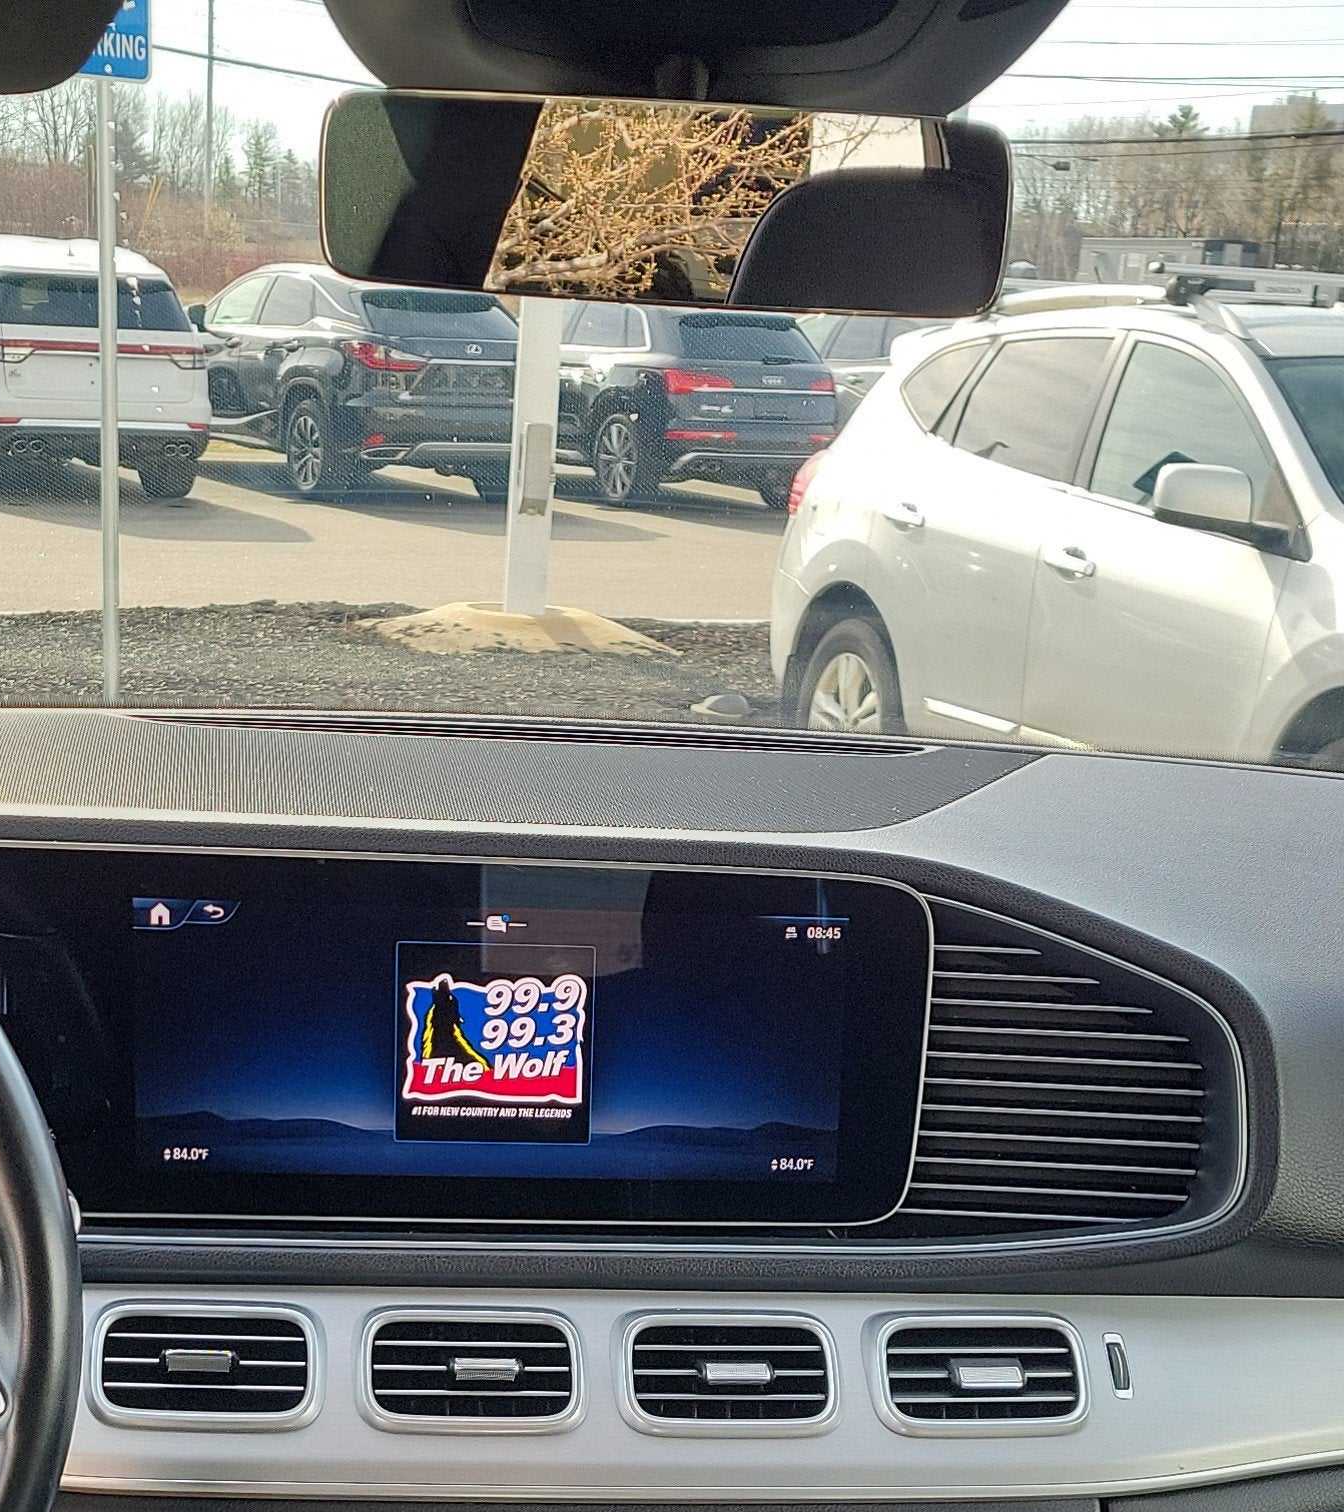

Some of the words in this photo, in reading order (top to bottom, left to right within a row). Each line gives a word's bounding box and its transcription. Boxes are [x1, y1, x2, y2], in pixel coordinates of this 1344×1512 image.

[93, 32, 146, 61] KING
[807, 926, 841, 939] 08:45
[484, 979, 581, 1016] 99.9
[480, 1013, 576, 1050] 99.3
[422, 1057, 484, 1085] The
[491, 1050, 569, 1080] Wolf
[422, 1106, 439, 1116] FOR
[440, 1106, 460, 1116] NEW
[460, 1106, 498, 1117] COUNTRY
[499, 1107, 517, 1118] AND
[518, 1108, 534, 1117] THE
[534, 1108, 573, 1119] LEGENDS
[172, 1147, 209, 1160] 84.0°F
[779, 1158, 814, 1171] 84.0°F
